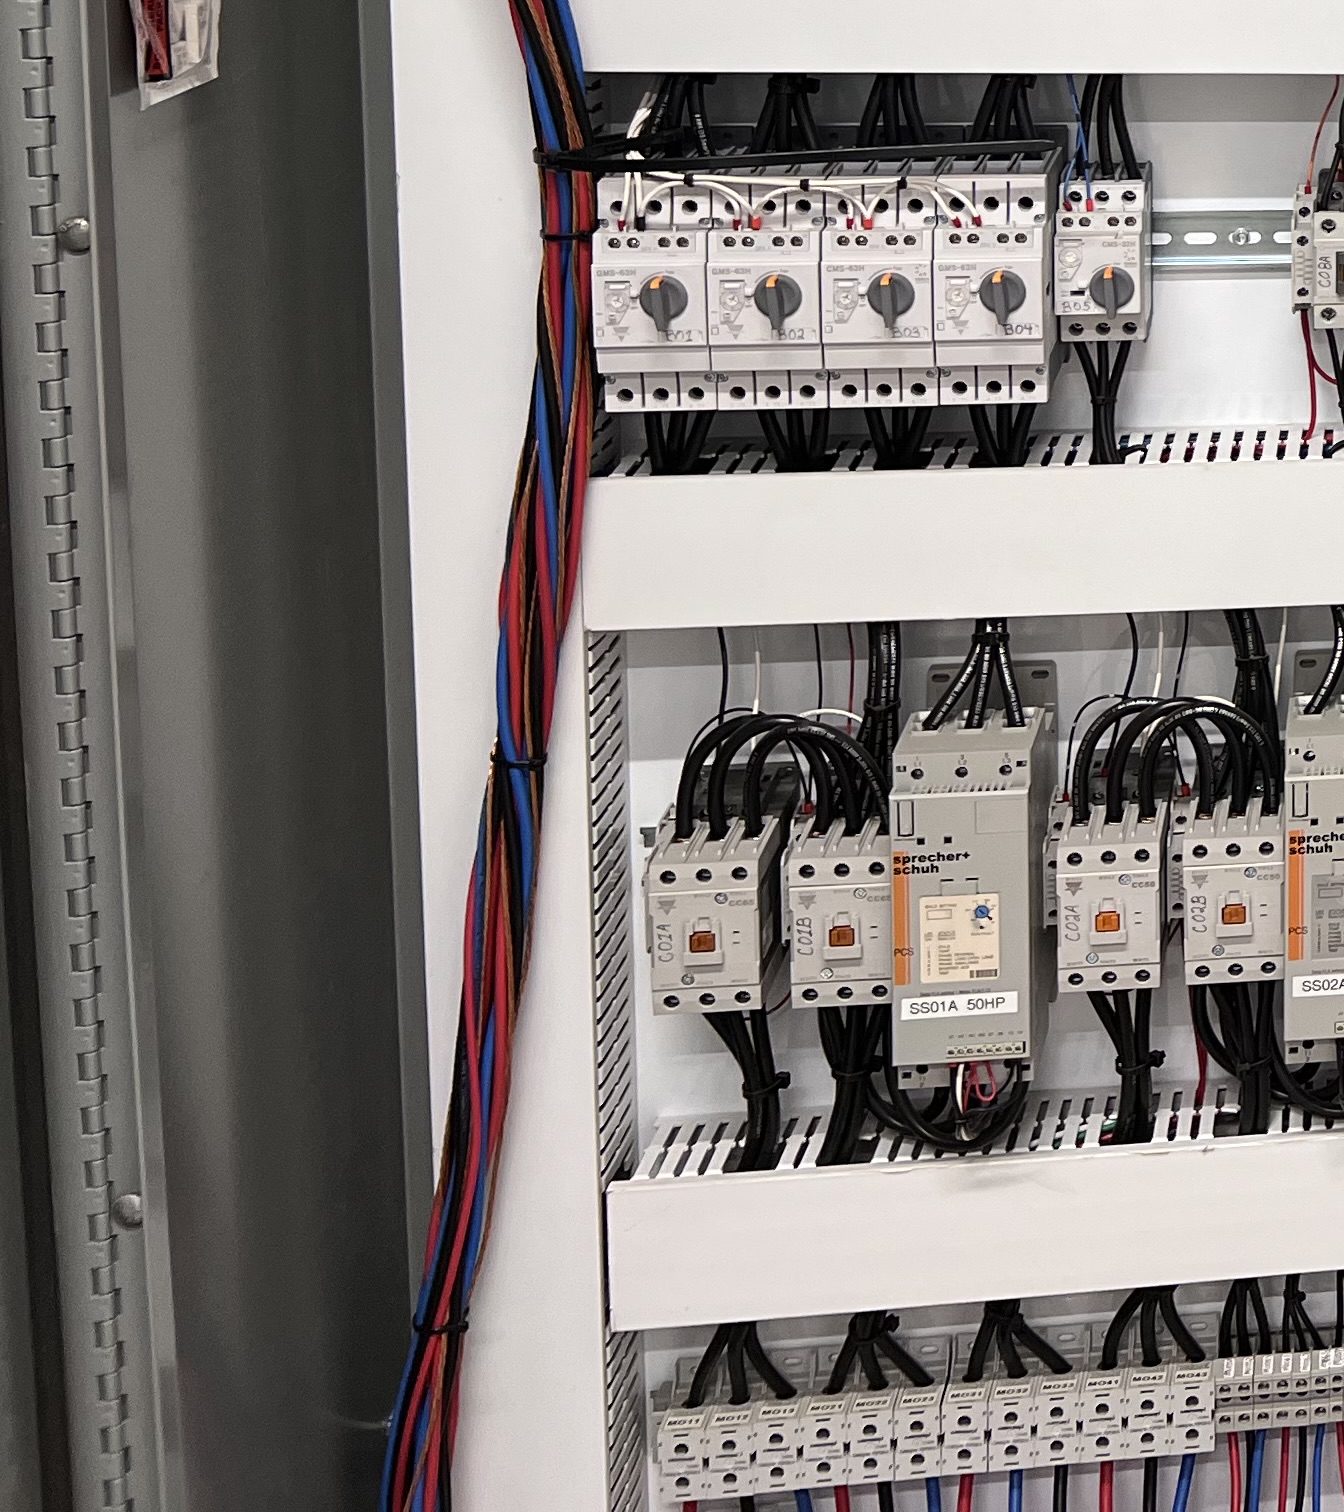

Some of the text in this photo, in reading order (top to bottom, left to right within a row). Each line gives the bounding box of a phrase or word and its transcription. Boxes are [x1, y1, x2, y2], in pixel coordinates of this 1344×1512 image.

[1289, 843, 1333, 855] schuh
[893, 851, 971, 865] sprecher+
[893, 864, 939, 875] schuh
[910, 997, 1005, 1015] SS01A 50HP
